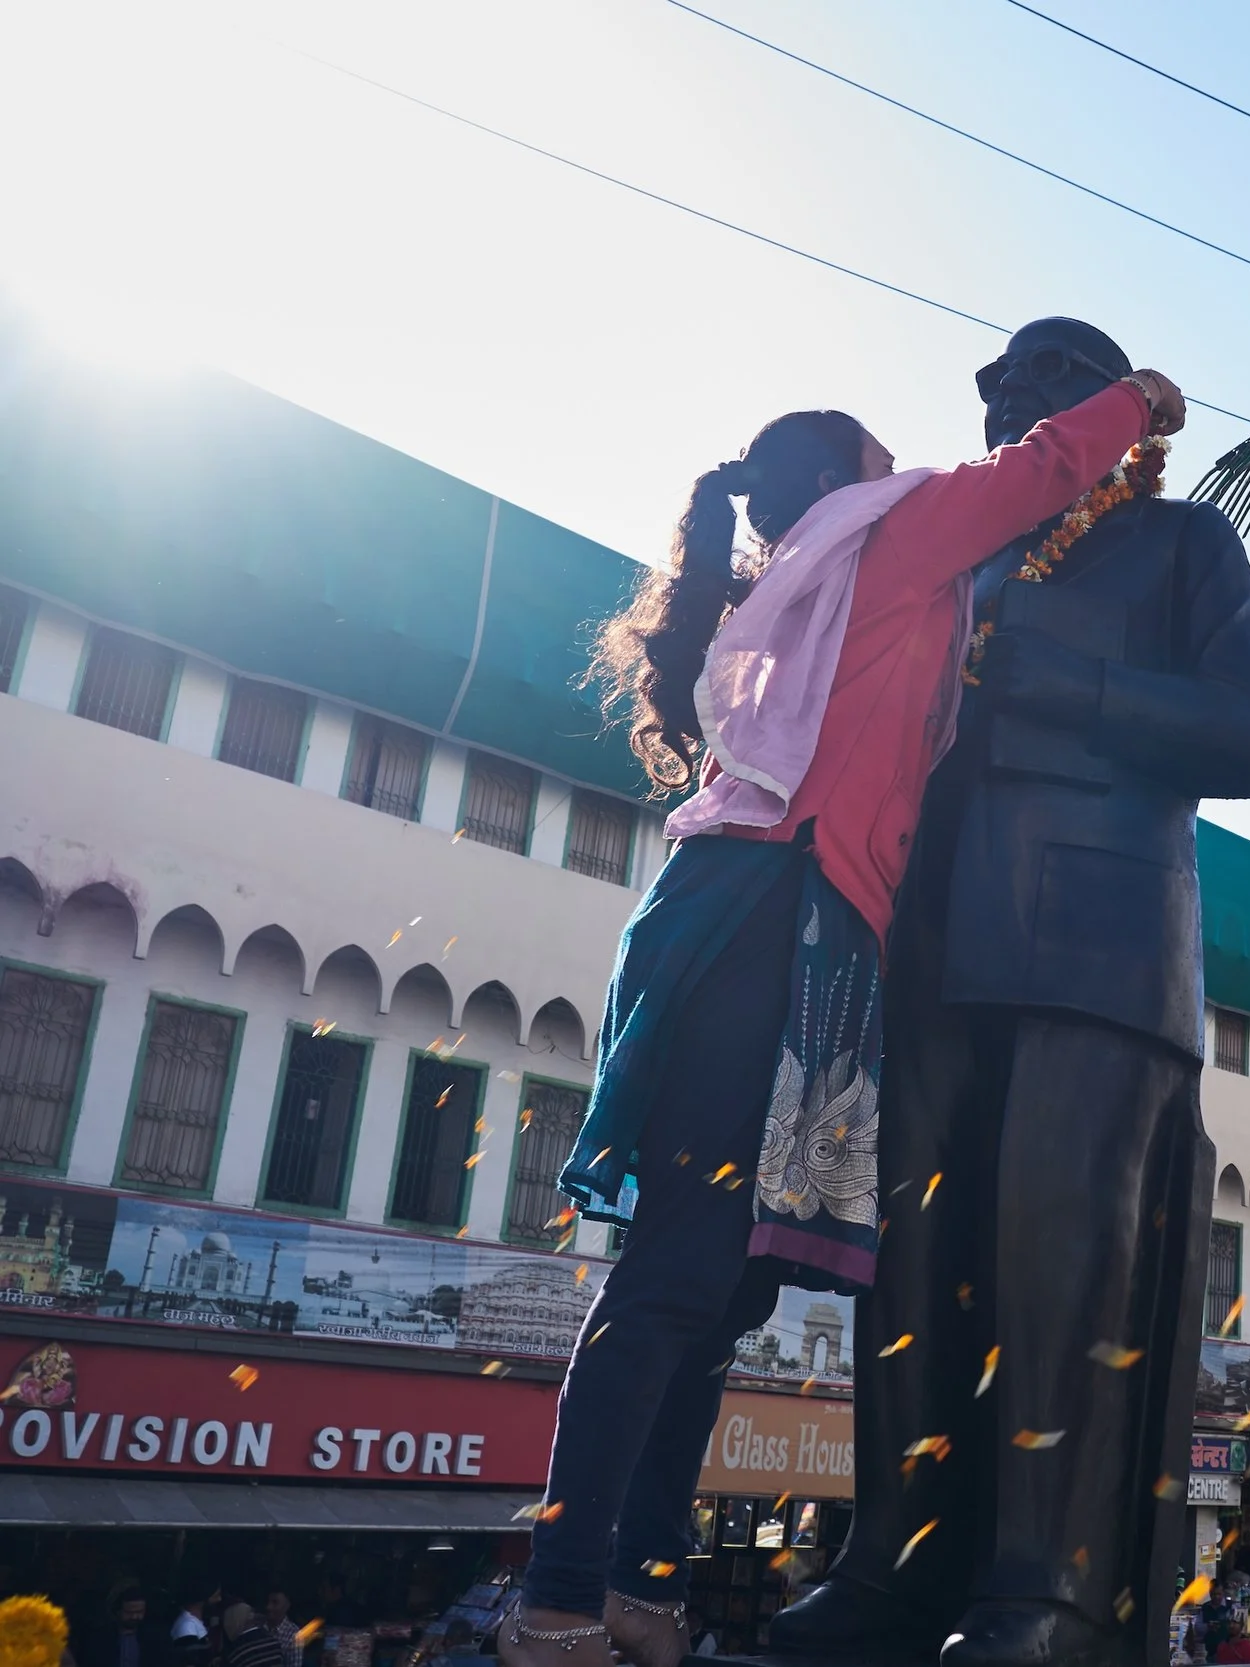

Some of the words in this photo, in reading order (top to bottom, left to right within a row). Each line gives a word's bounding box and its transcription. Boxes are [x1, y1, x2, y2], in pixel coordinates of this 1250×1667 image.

[0, 1288, 56, 1307] मिनार
[163, 1307, 194, 1321] ताज
[198, 1311, 236, 1326] महल
[0, 1408, 272, 1467] OVISION
[310, 1426, 485, 1477] STORE
[722, 1414, 789, 1473] Glass
[1187, 1476, 1229, 1500] CENTRE
